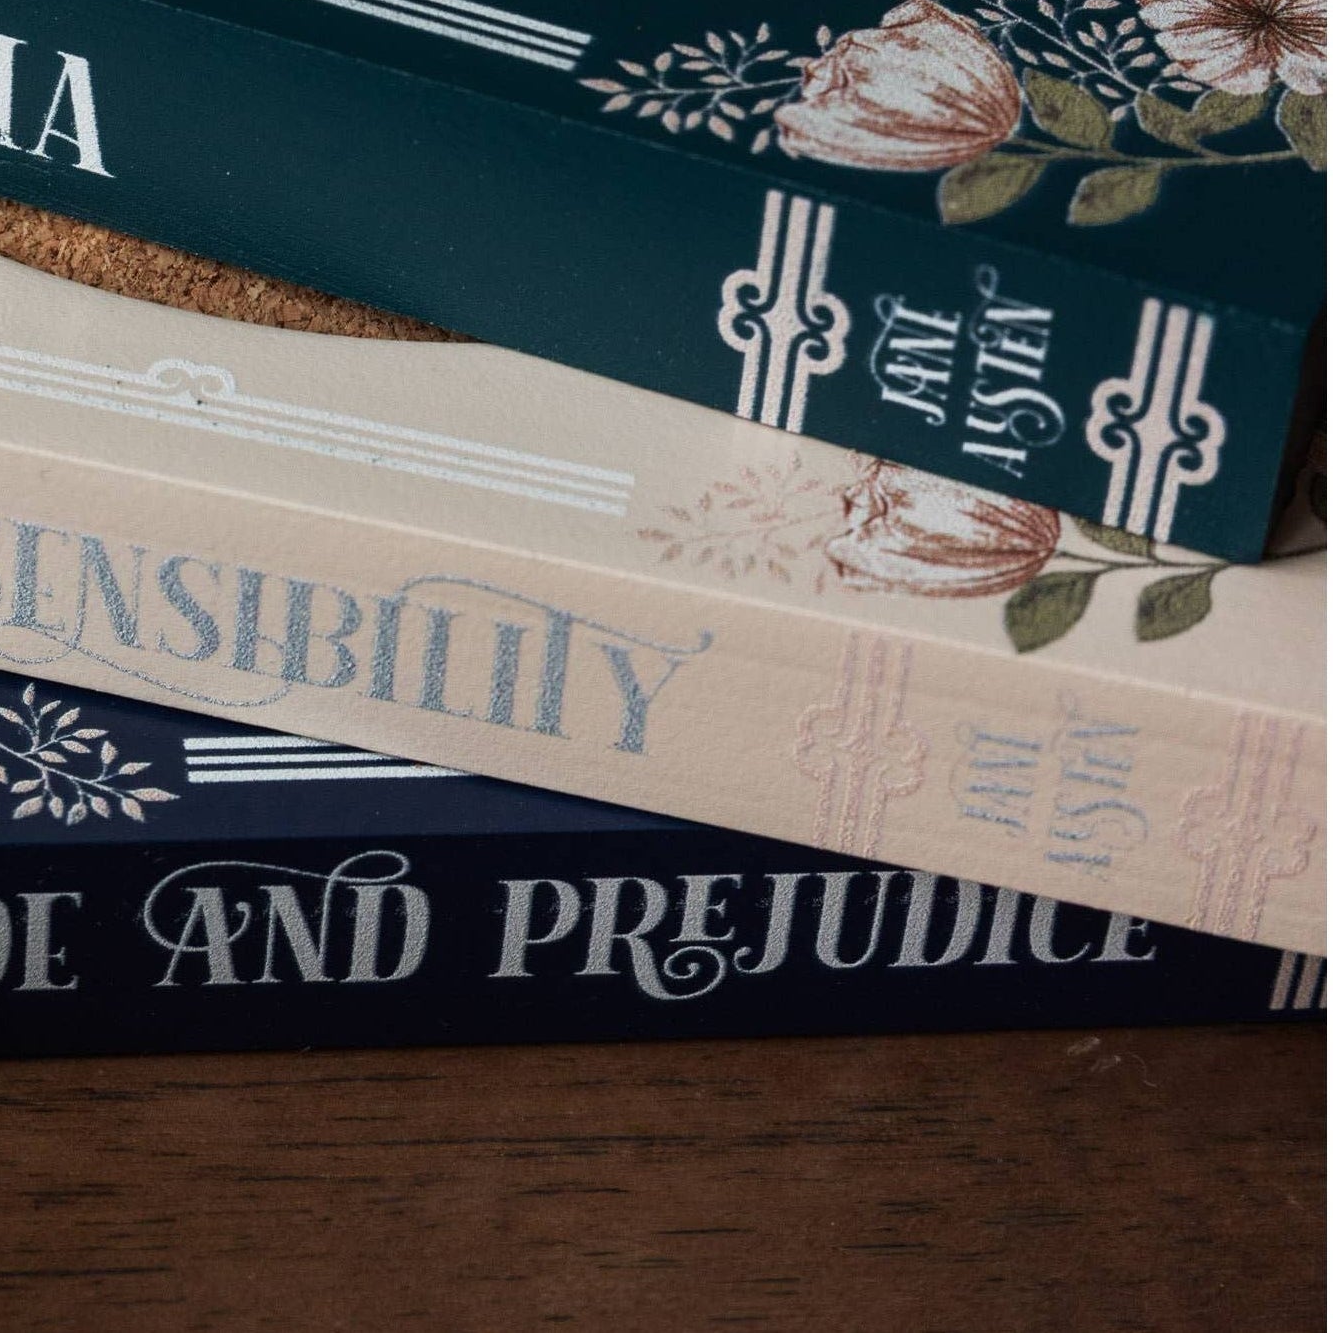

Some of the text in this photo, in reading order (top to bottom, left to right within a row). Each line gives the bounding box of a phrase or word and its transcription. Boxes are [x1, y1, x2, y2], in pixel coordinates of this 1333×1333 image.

[870, 293, 962, 426] JANE
[963, 264, 1065, 479] AUSTEN
[144, 850, 431, 987] AND
